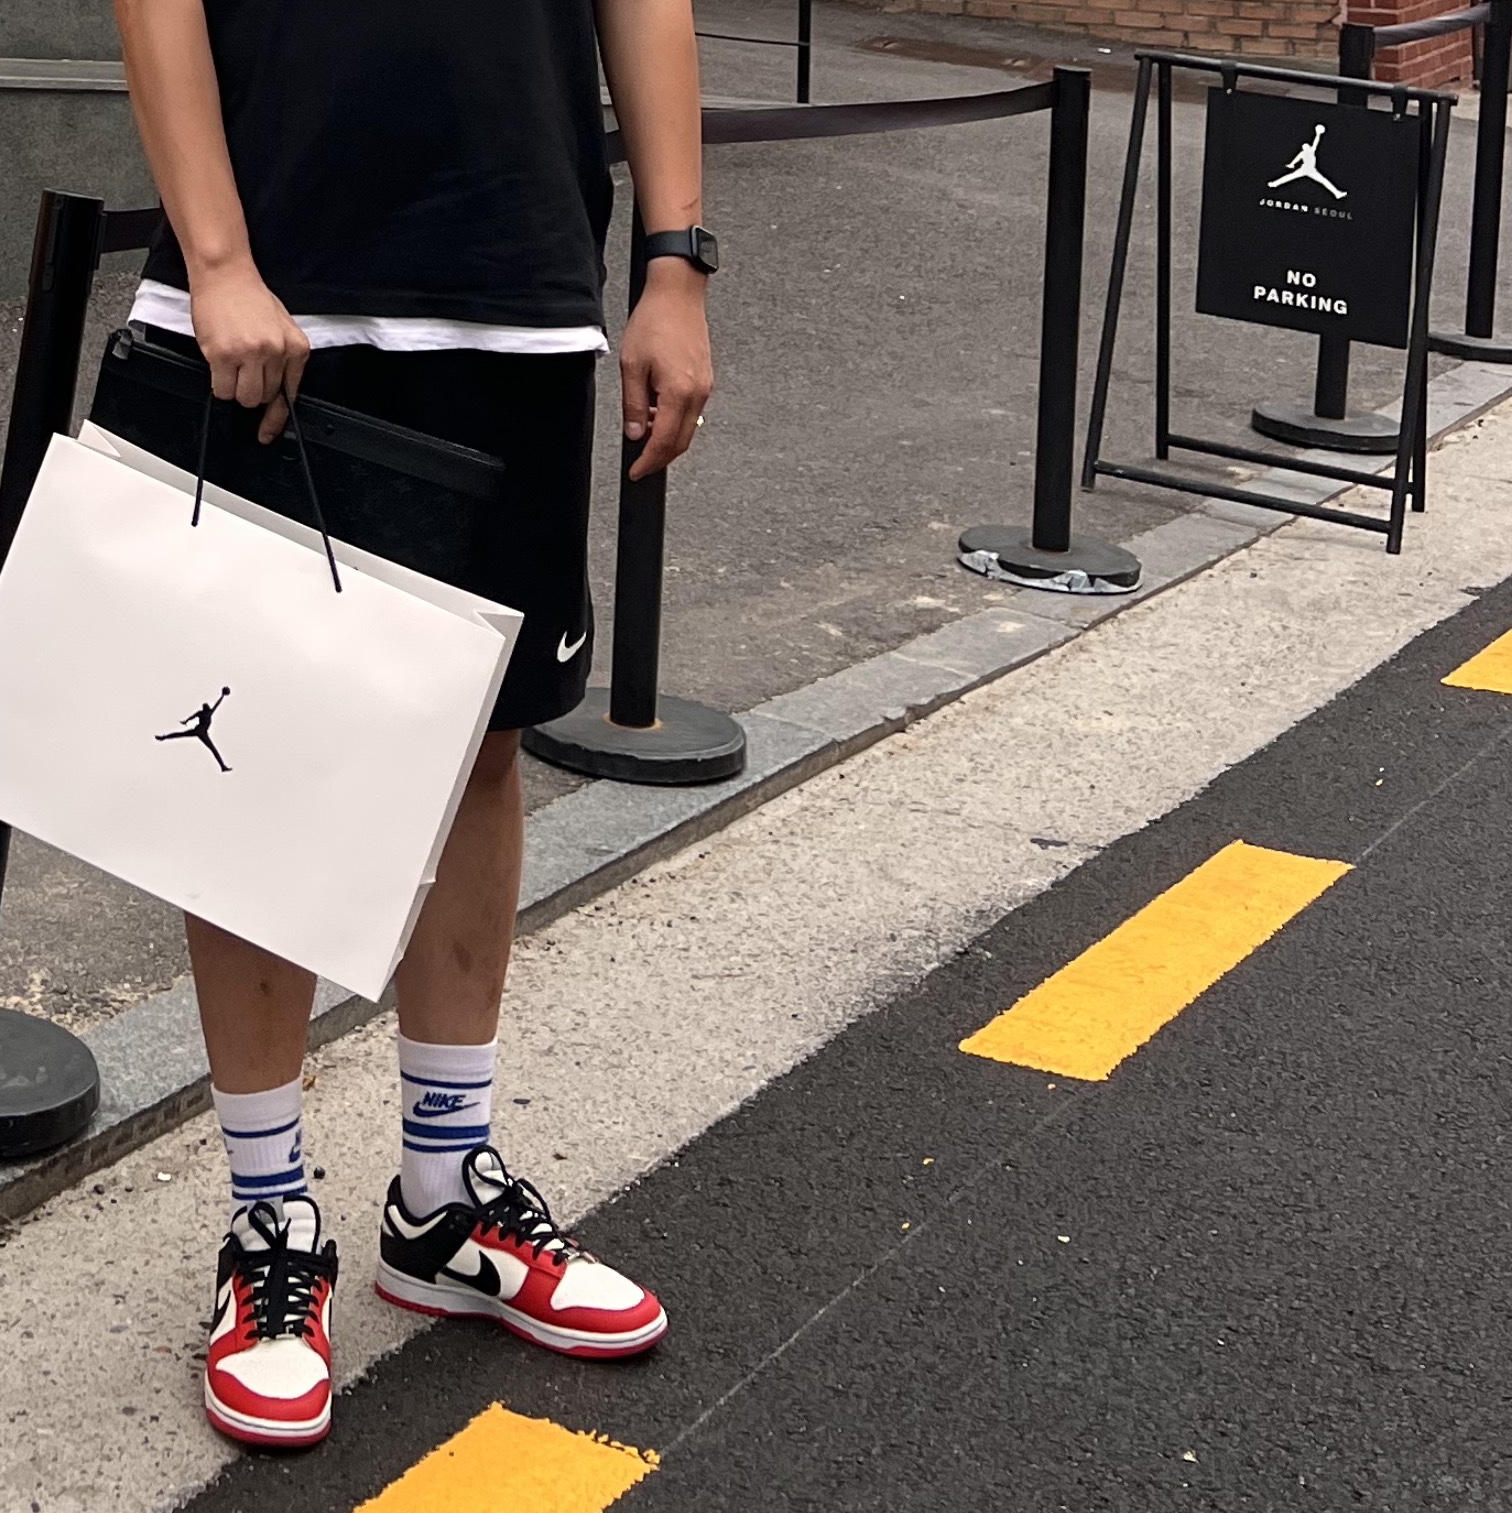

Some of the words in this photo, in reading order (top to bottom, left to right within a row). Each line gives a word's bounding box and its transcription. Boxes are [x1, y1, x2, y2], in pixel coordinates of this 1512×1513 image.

[1259, 198, 1309, 213] JORDAN
[1314, 206, 1354, 220] SEOUL
[1286, 269, 1317, 288] NO
[1253, 285, 1348, 315] PARKING
[422, 1091, 467, 1108] NIKE
